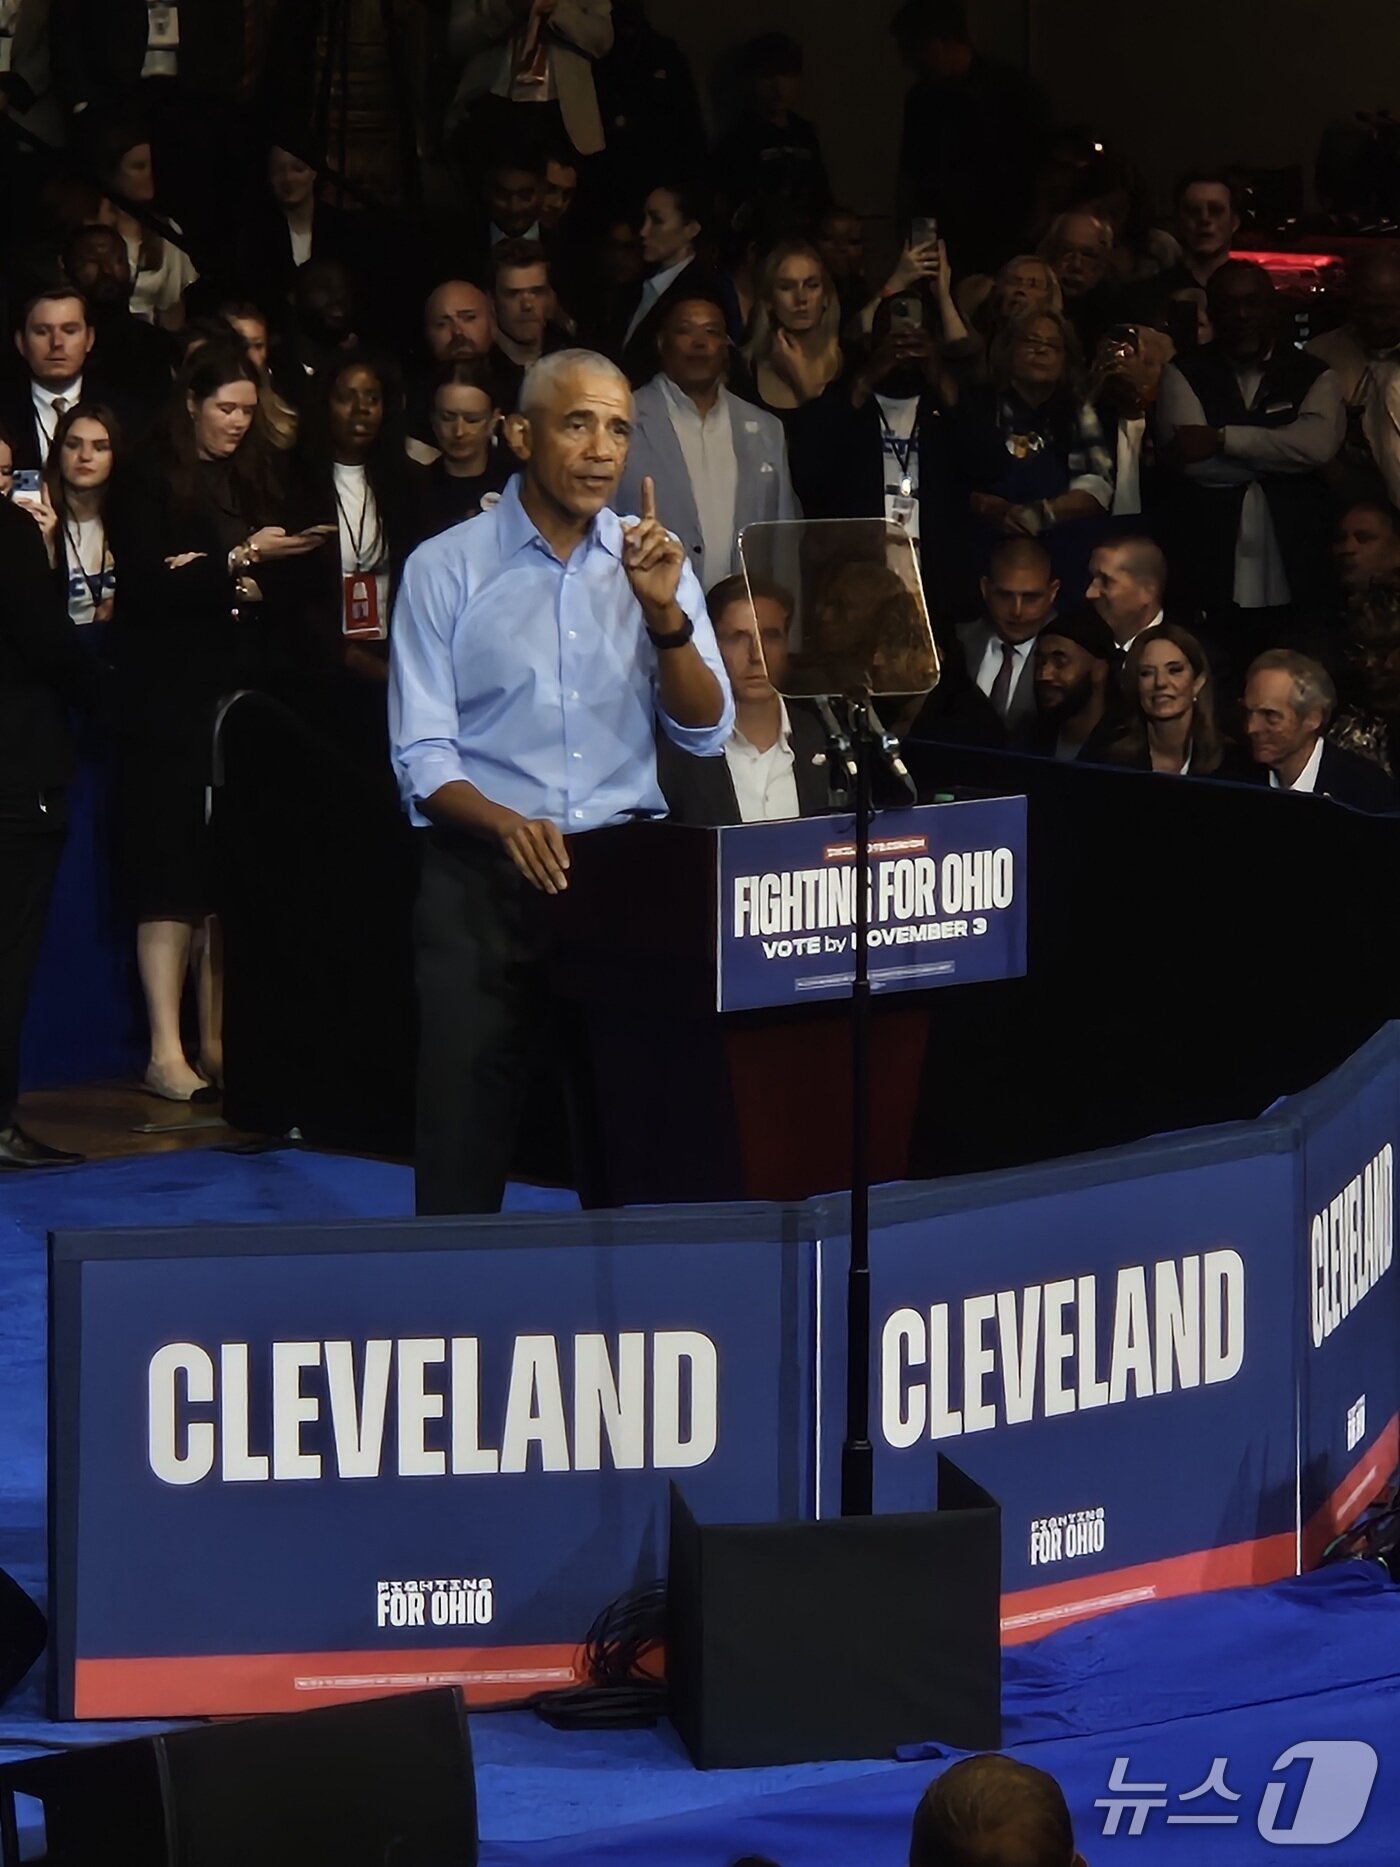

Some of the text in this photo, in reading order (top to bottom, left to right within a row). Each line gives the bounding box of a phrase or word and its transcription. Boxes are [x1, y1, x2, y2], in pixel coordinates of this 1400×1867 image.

[879, 857, 935, 921] FOR
[941, 847, 1013, 914] OHIO
[762, 937, 821, 960] VOTE
[824, 934, 847, 953] by
[973, 917, 988, 935] 3
[1309, 1142, 1393, 1348] CLEVELAND
[881, 1248, 1246, 1449] CLEVELAND
[147, 1331, 718, 1486] CLEVELAND
[1031, 1519, 1104, 1566] FOR OHIO
[377, 1589, 492, 1627] FOR OHIO
